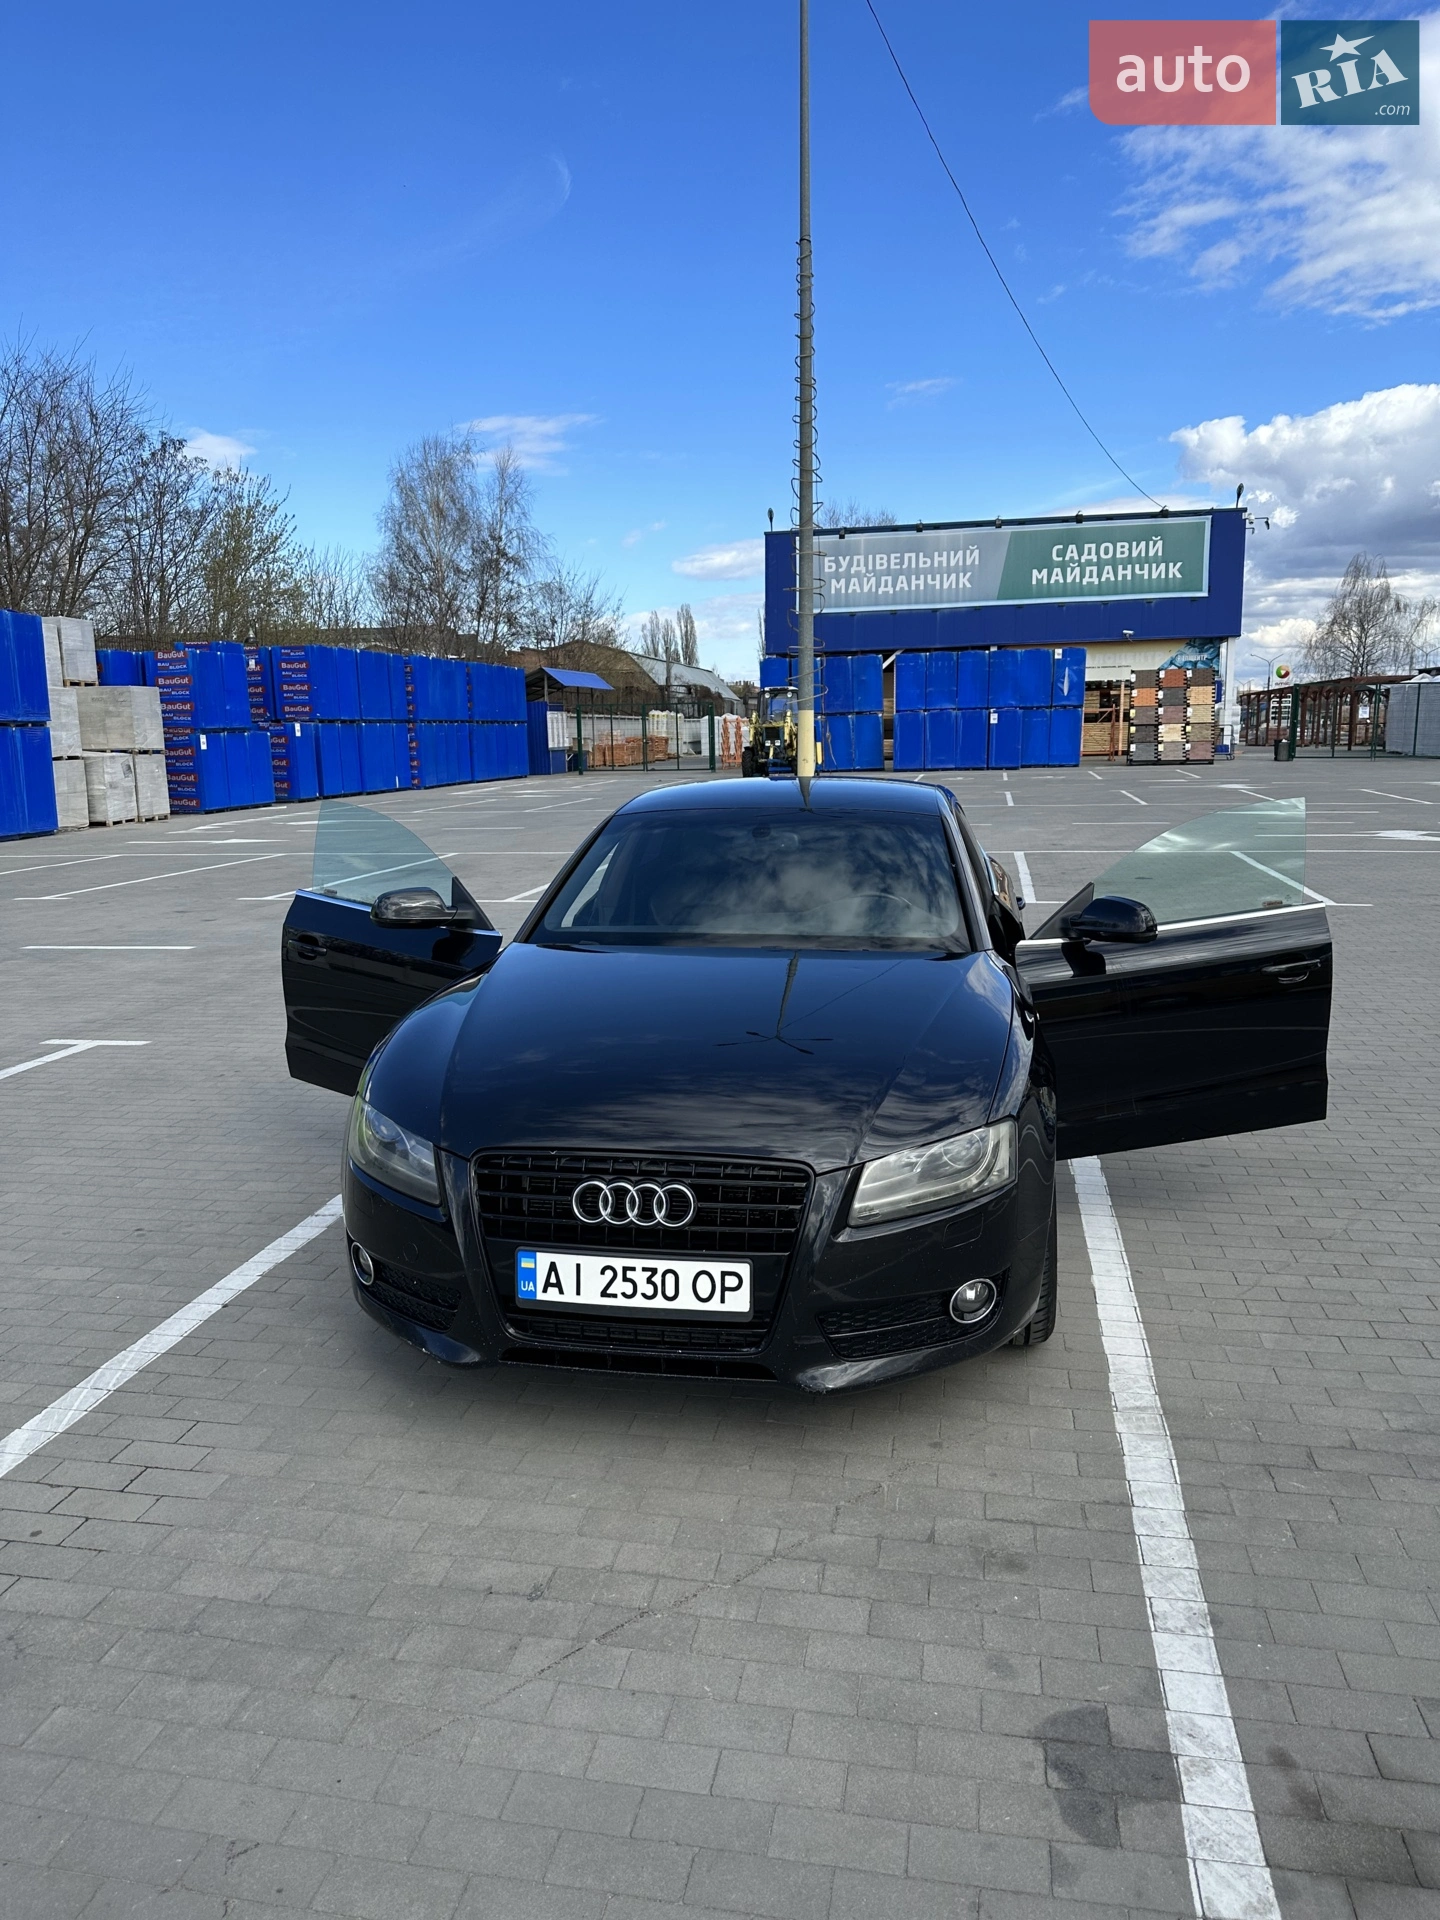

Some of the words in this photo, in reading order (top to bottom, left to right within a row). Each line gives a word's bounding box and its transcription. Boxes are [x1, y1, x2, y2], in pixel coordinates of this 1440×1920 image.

[824, 545, 980, 574] БУДІВЕЛЬНИЙ
[1052, 536, 1163, 563] САДОВИЙ
[830, 572, 972, 595] МАЙДАНЧИК
[1031, 561, 1183, 585] МАЙДАНЧИК
[157, 651, 184, 659] BauGut
[158, 677, 189, 685] BauGut
[161, 702, 191, 711] BauGut
[521, 1281, 535, 1292] UA
[541, 1261, 581, 1296] AI
[600, 1265, 680, 1302] 2530
[692, 1269, 744, 1304] OP
